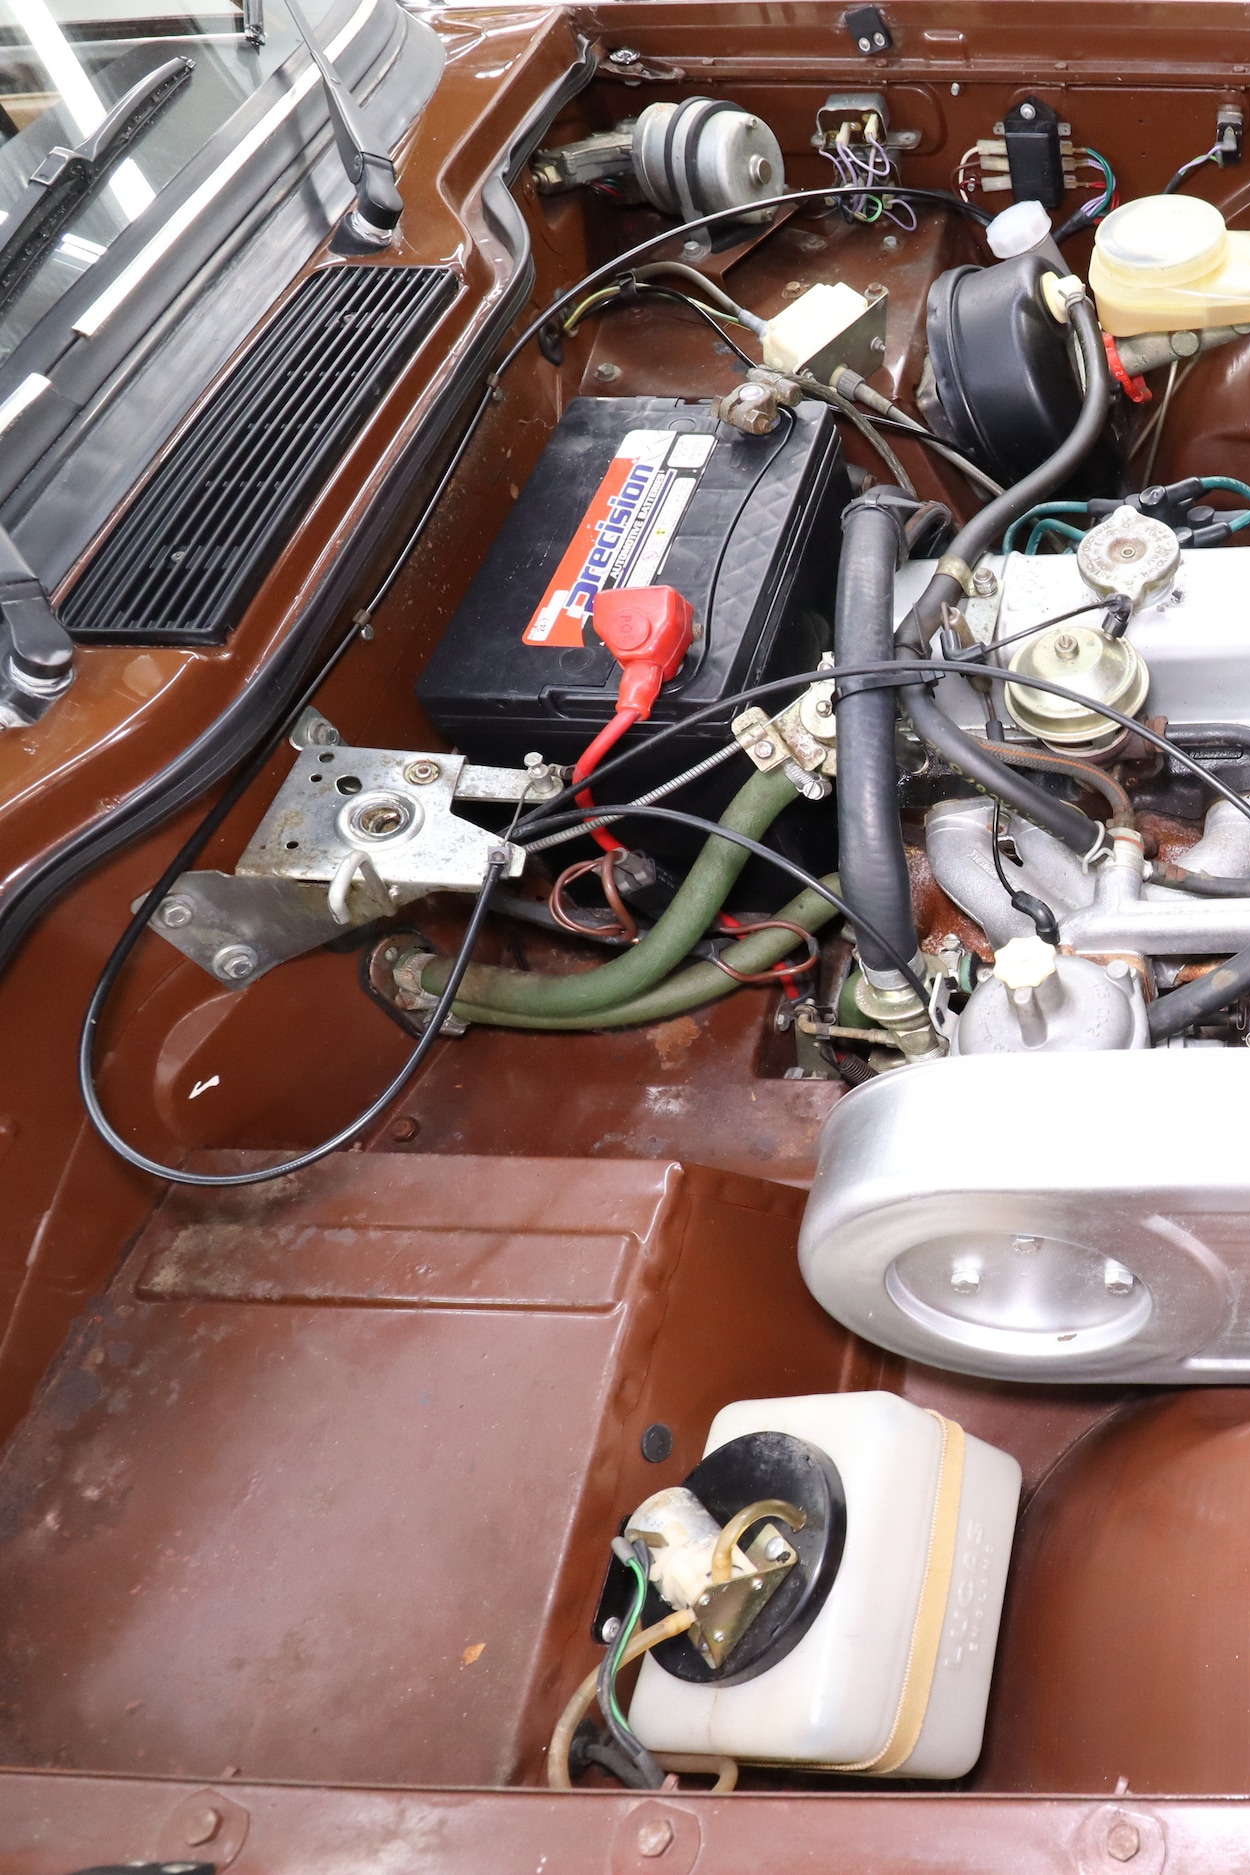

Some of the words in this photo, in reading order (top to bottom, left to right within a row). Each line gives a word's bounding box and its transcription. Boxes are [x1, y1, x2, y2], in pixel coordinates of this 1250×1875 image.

[610, 520, 644, 580] AUTOMOTIVE
[638, 472, 666, 521] BATTERIES
[944, 1517, 984, 1672] LUCAS
